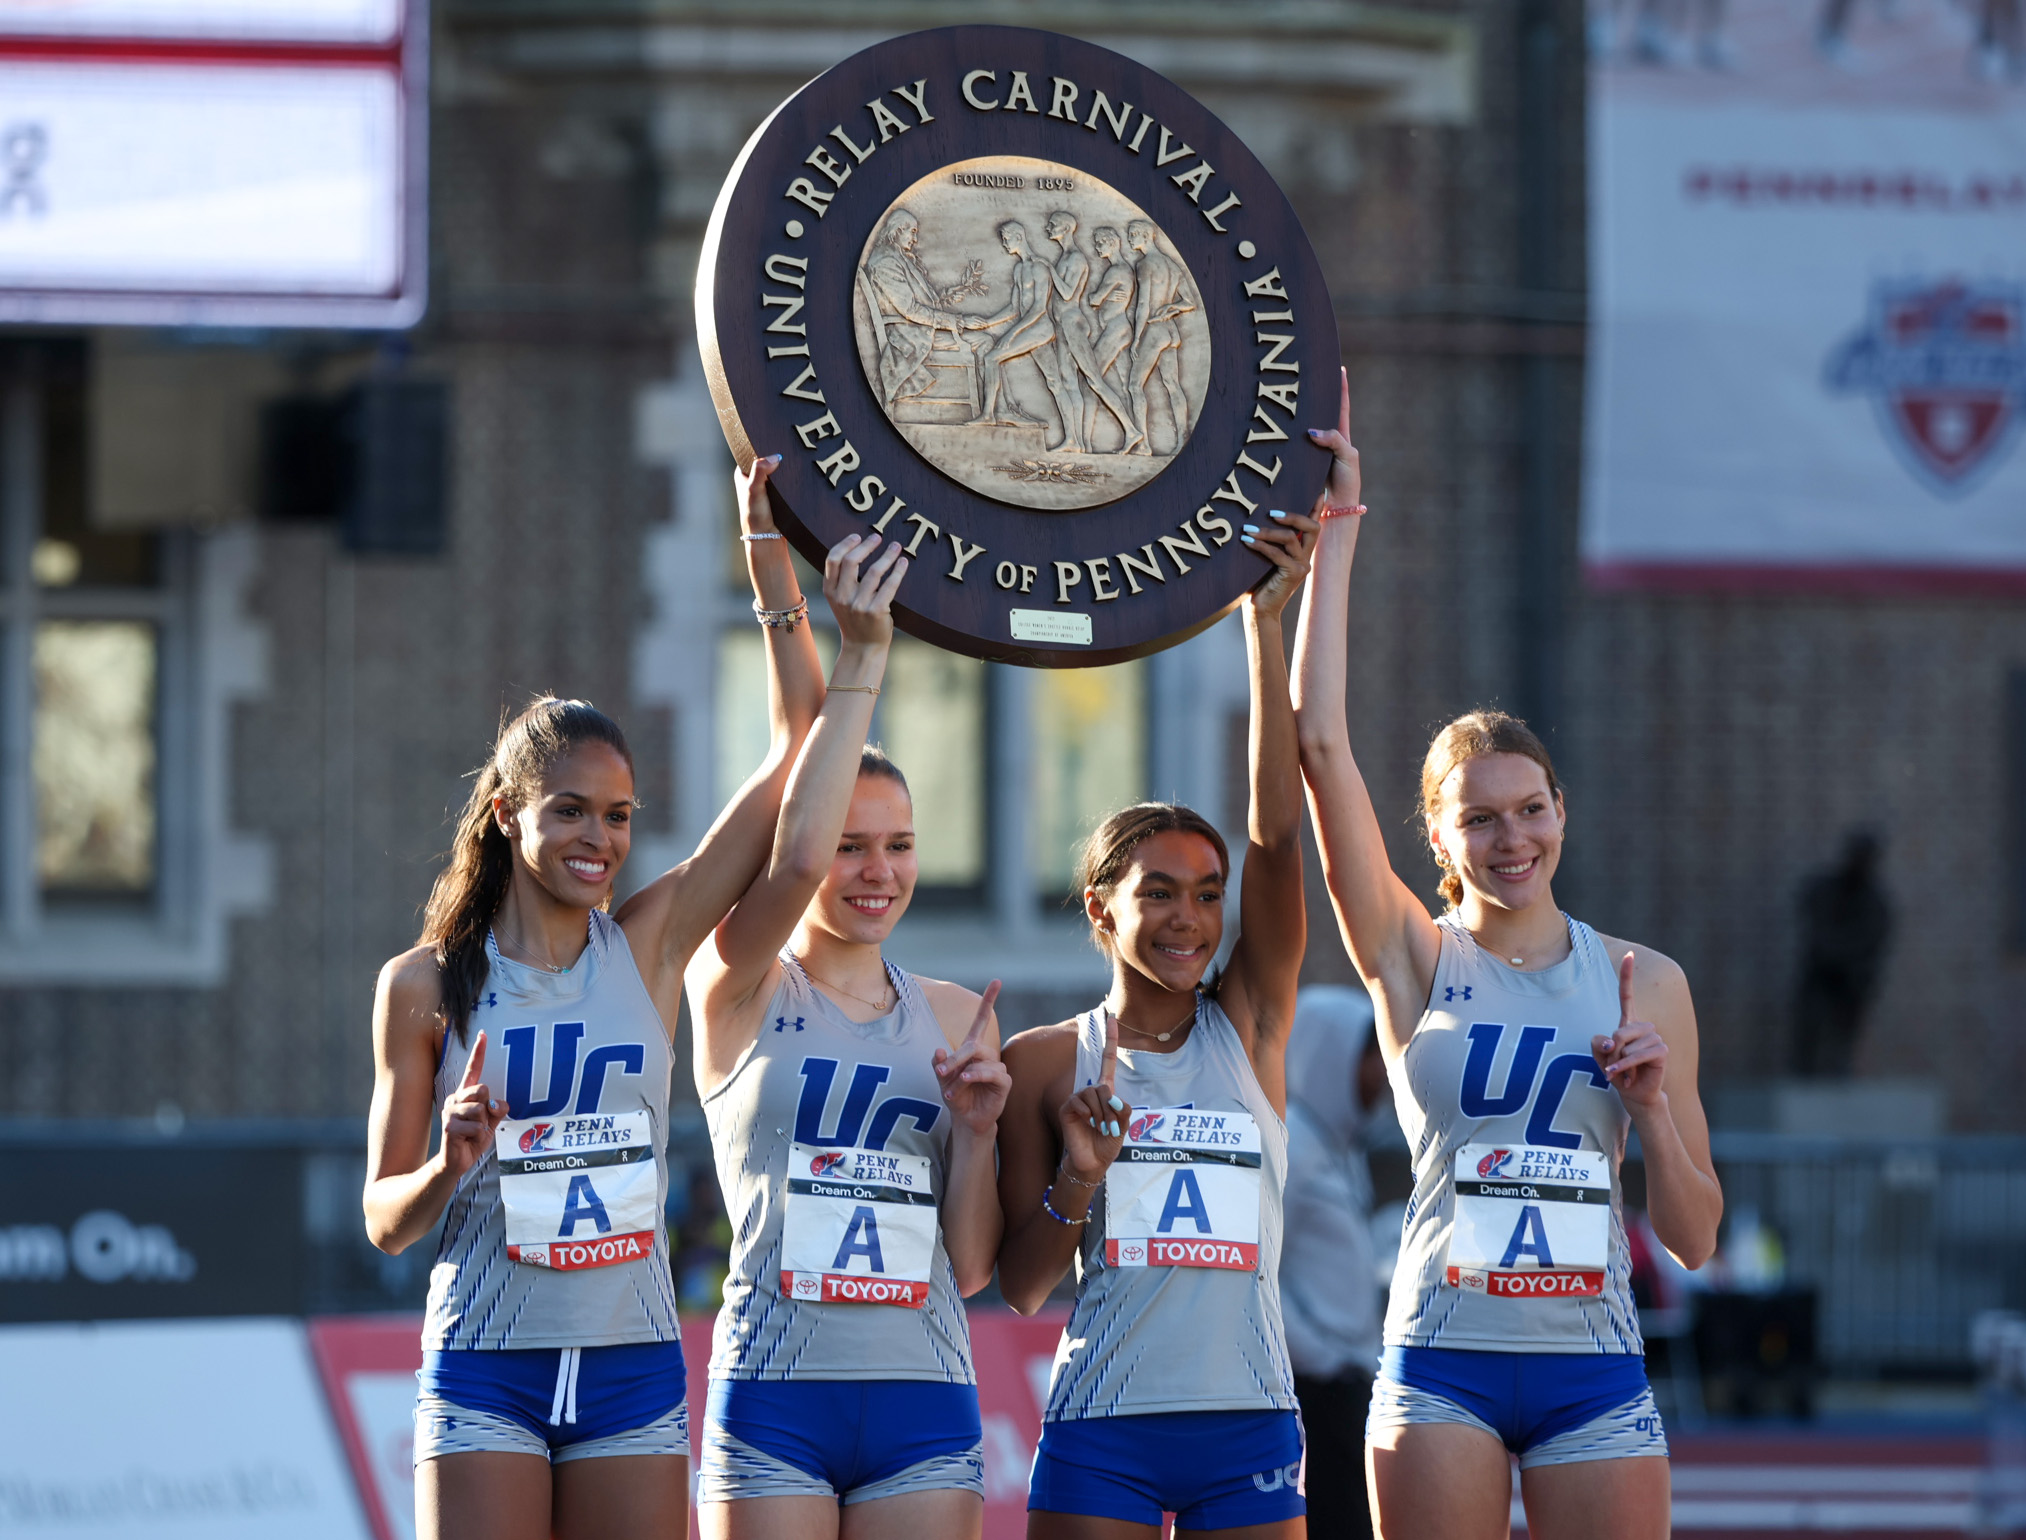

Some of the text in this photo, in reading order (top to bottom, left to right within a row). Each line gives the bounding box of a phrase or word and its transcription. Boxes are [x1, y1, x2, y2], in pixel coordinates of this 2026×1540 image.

[785, 69, 1242, 234] RELAY CARNIVAL
[953, 173, 1074, 191] FOUNDED 1895
[762, 252, 988, 581] UNIVERSITY
[1052, 265, 1301, 604] PENNSYLVANIA
[501, 1021, 645, 1121] UC
[1459, 1022, 1612, 1149] UC
[793, 1056, 943, 1151] UC
[563, 1116, 616, 1132] PENN
[1174, 1114, 1227, 1130] PENN
[562, 1129, 631, 1148] RELAYS
[1170, 1129, 1242, 1145] RELAYS
[523, 1156, 588, 1172] Dream On.
[855, 1154, 900, 1169] PENN
[1131, 1150, 1193, 1162] Dream On.
[1522, 1151, 1574, 1167] PENN
[853, 1167, 913, 1186] RELAYS
[1518, 1164, 1590, 1181] RELAYS
[811, 1183, 877, 1200] Dream On.
[1480, 1184, 1540, 1199] Dream On.
[557, 1174, 612, 1237] A
[1156, 1169, 1213, 1234] A
[832, 1205, 885, 1273] A
[1498, 1205, 1555, 1268] A
[555, 1238, 641, 1266] TOYOTA
[1153, 1242, 1244, 1265] TOYOTA
[827, 1278, 914, 1303] TOYOTA
[1493, 1274, 1587, 1293] TOYOTA
